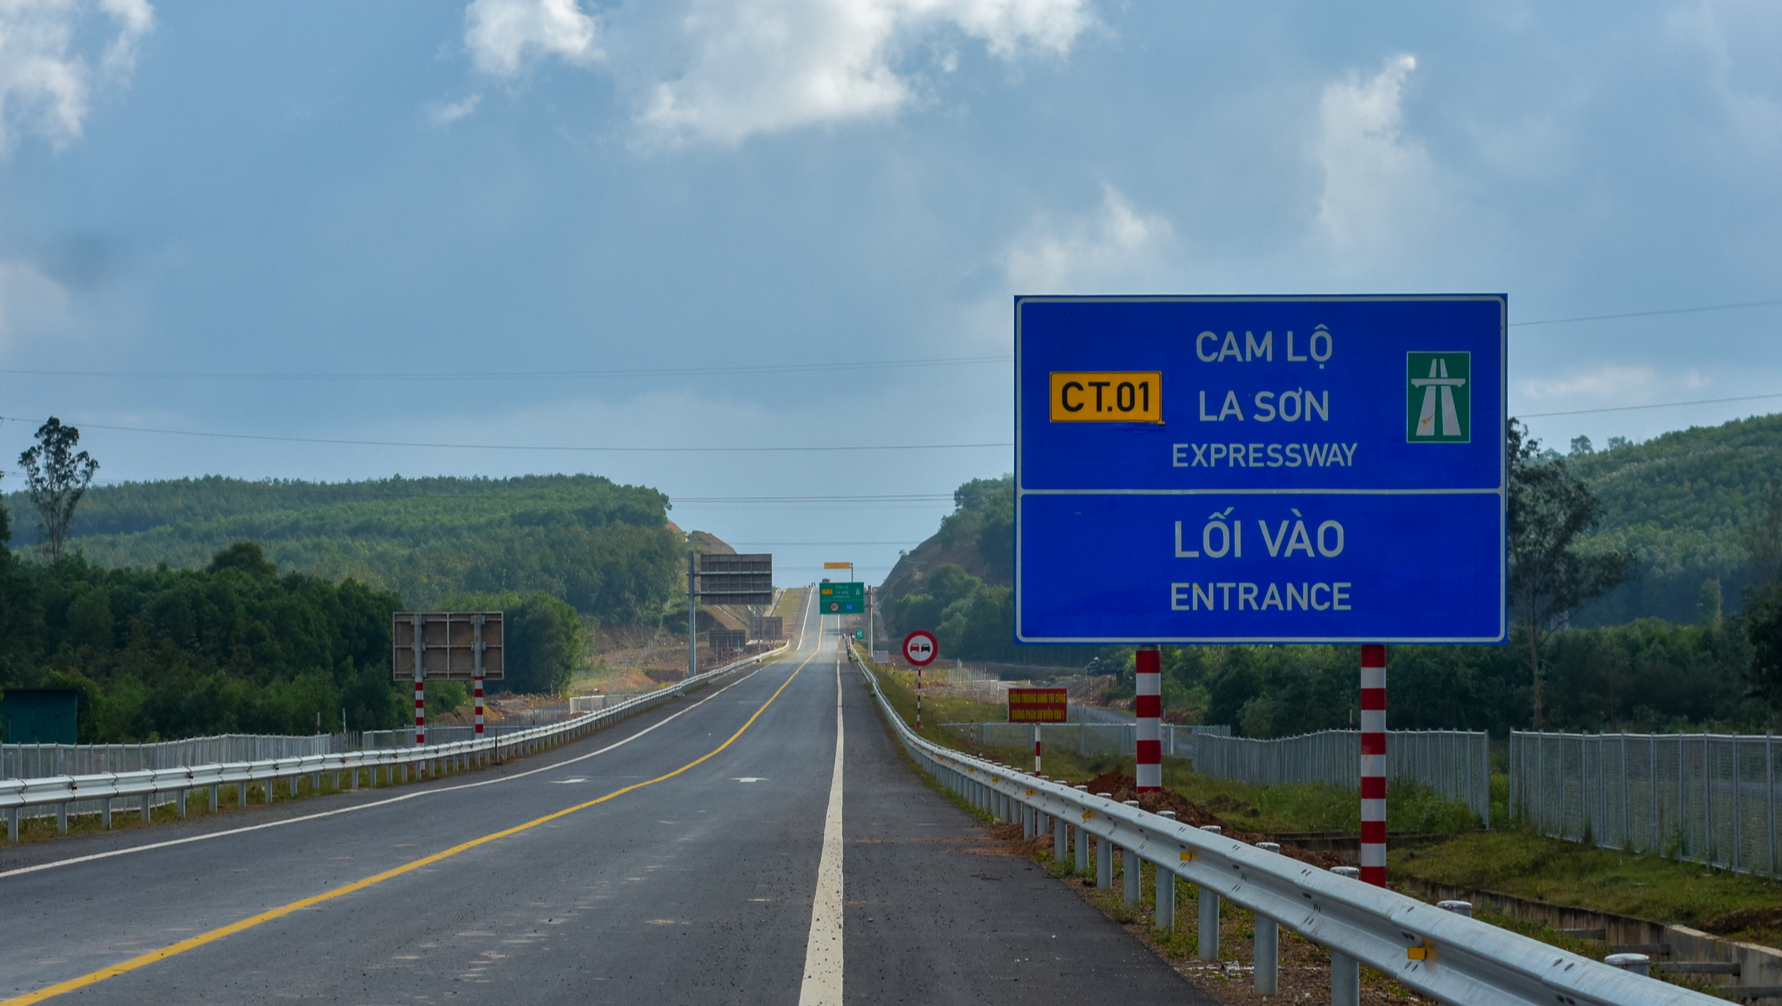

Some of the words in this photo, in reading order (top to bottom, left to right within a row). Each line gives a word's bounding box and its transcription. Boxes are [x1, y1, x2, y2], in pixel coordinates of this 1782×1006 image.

[1196, 331, 1273, 362] CAM
[1287, 324, 1333, 369] LỘ
[1061, 381, 1150, 413] CT.01
[1199, 391, 1244, 421] LA
[1254, 387, 1329, 422] SƠN
[1172, 443, 1358, 467] EXPRESSWAY
[1174, 507, 1242, 558] LỐI
[1258, 508, 1344, 558] VÀO
[1171, 582, 1351, 611] ENTRANCE
